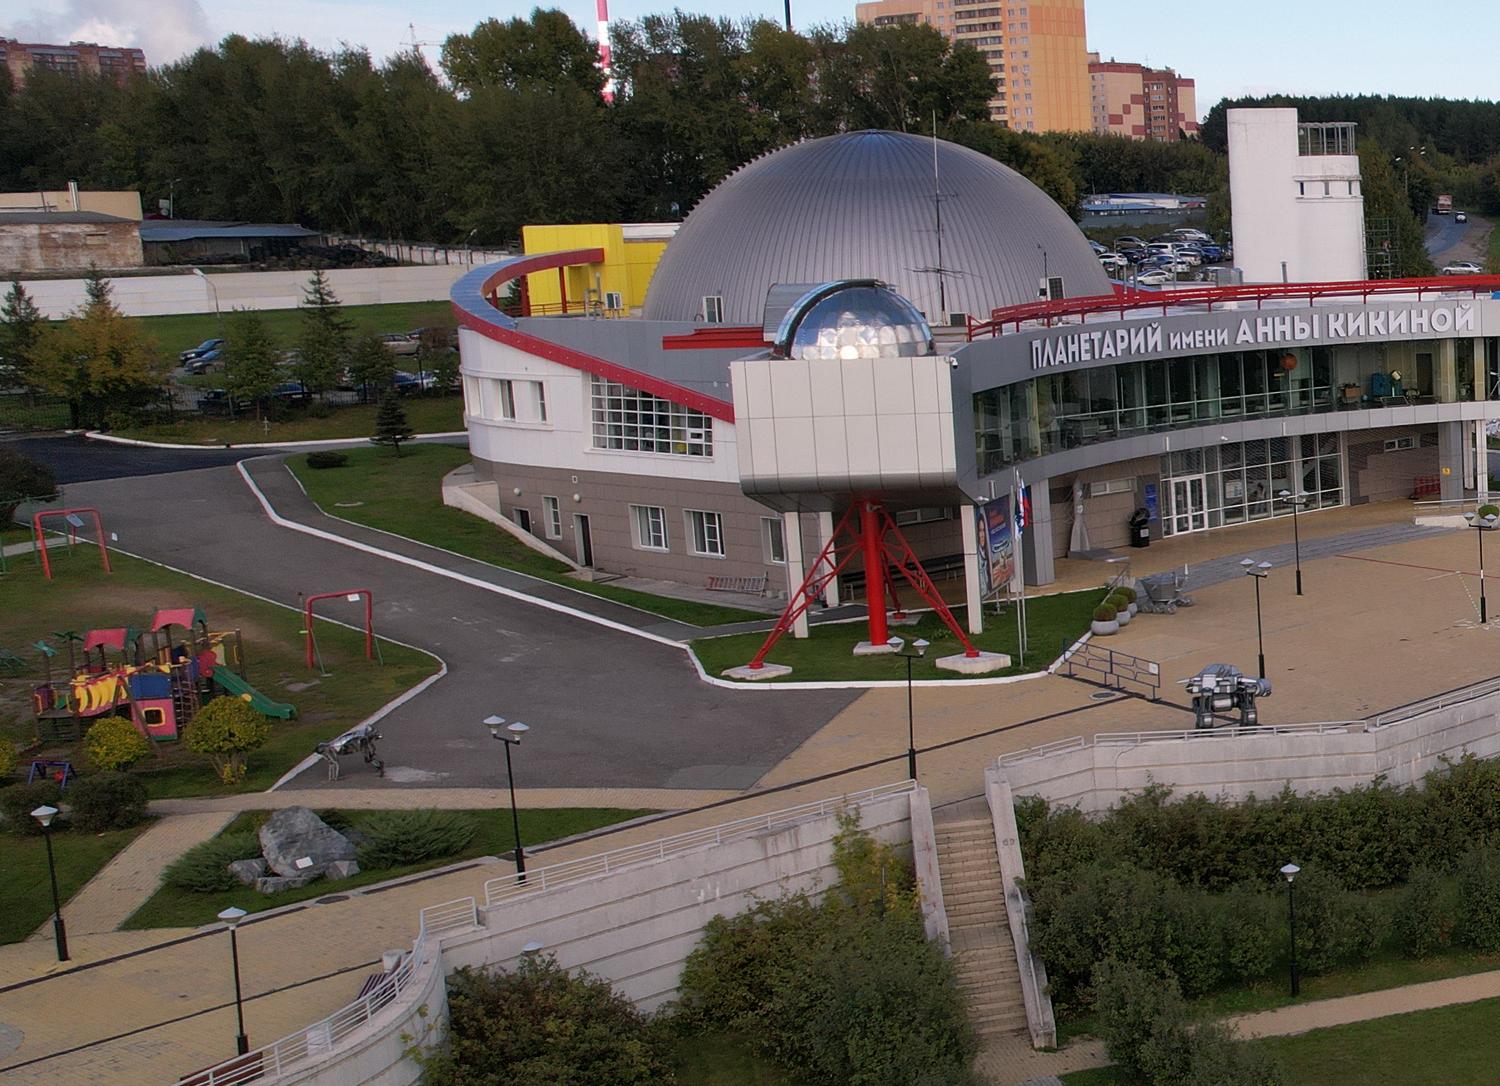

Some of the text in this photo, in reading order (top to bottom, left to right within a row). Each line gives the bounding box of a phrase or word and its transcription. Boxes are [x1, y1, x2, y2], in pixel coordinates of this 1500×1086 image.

[1031, 303, 1474, 370] ПЛАНЕТАРИЙ ИМЕНИ АННЫ КИКИНОЙ
